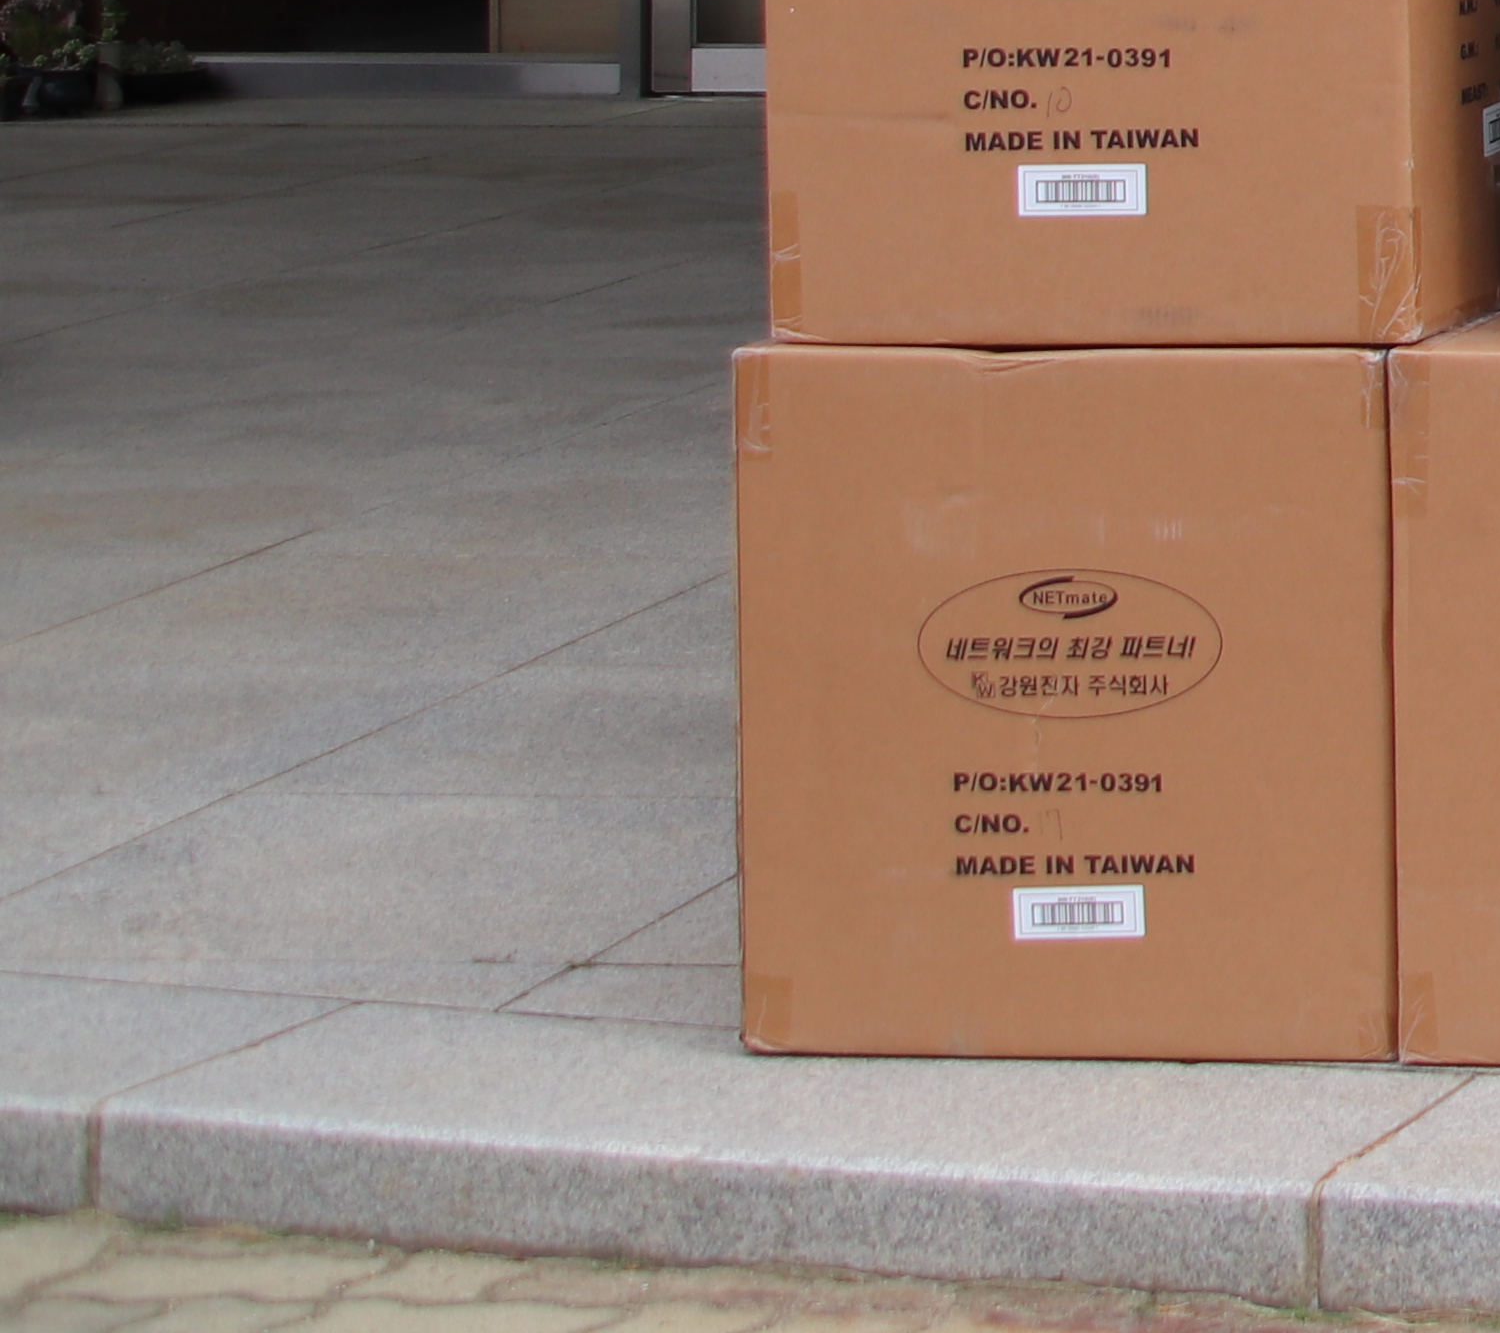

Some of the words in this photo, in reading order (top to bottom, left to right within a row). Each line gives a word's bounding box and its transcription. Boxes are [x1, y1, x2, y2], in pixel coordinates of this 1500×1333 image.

[962, 47, 1170, 69] P/O:KW21-0391
[963, 89, 1037, 110] C/NO.
[1046, 86, 1073, 118] 10
[965, 131, 1043, 152] MADE
[1053, 130, 1081, 151] IN
[1090, 128, 1199, 150] TAIWAN
[1031, 589, 1110, 604] NETmate
[945, 637, 1059, 662] 네트워크의
[1066, 636, 1112, 661] 최강
[1119, 635, 1196, 660] 파트너!
[999, 675, 1079, 698] 강원전자
[1088, 674, 1168, 697] 주식회사
[953, 772, 1162, 793] P/O:KW21-0391
[954, 814, 1029, 834] C/NO.
[955, 855, 1035, 877] MADE
[1046, 855, 1074, 875] IN
[1083, 854, 1195, 875] TAIWAN
